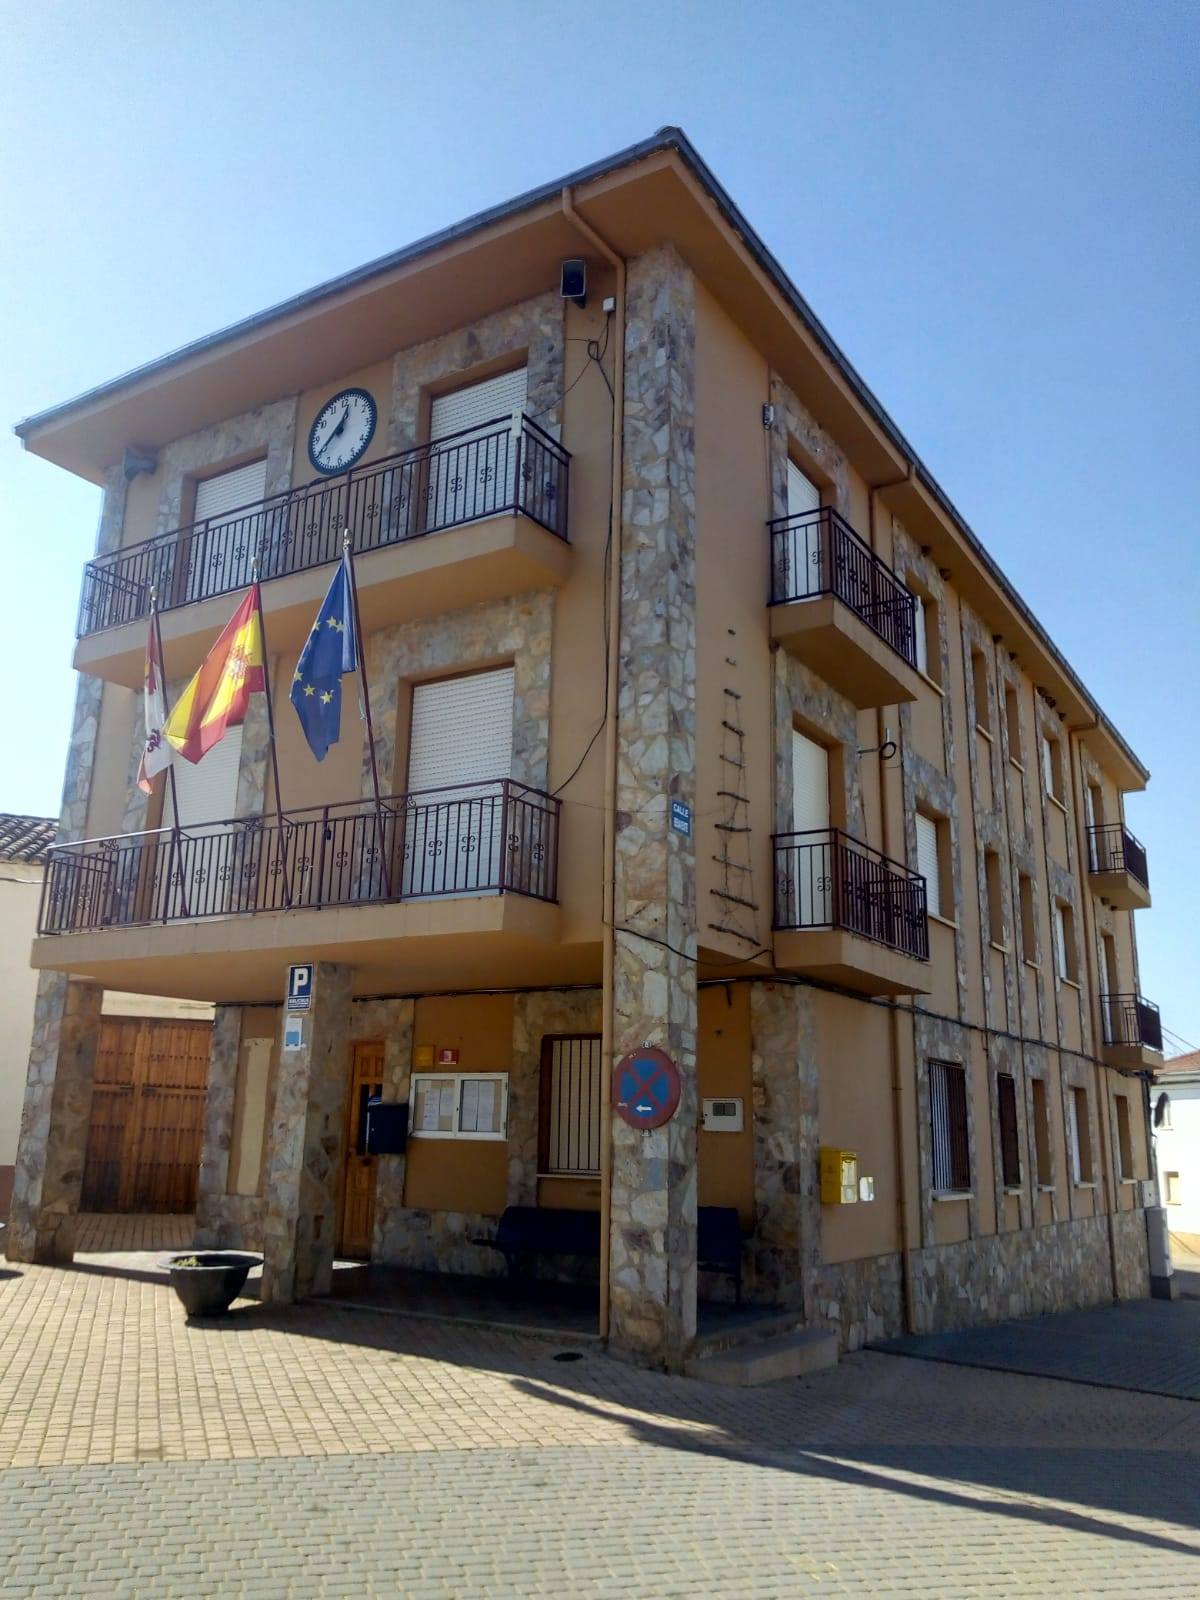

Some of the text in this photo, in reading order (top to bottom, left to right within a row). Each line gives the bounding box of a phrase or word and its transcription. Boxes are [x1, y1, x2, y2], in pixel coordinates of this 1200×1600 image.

[341, 399, 348, 408] 12
[331, 406, 337, 415] 11
[361, 404, 367, 413] 2
[320, 420, 327, 429] 10
[315, 436, 320, 444] 9
[359, 434, 364, 442] 4
[326, 456, 331, 464] 7
[337, 456, 342, 466] 6
[673, 803, 689, 818] CALLE
[292, 967, 309, 996] P
